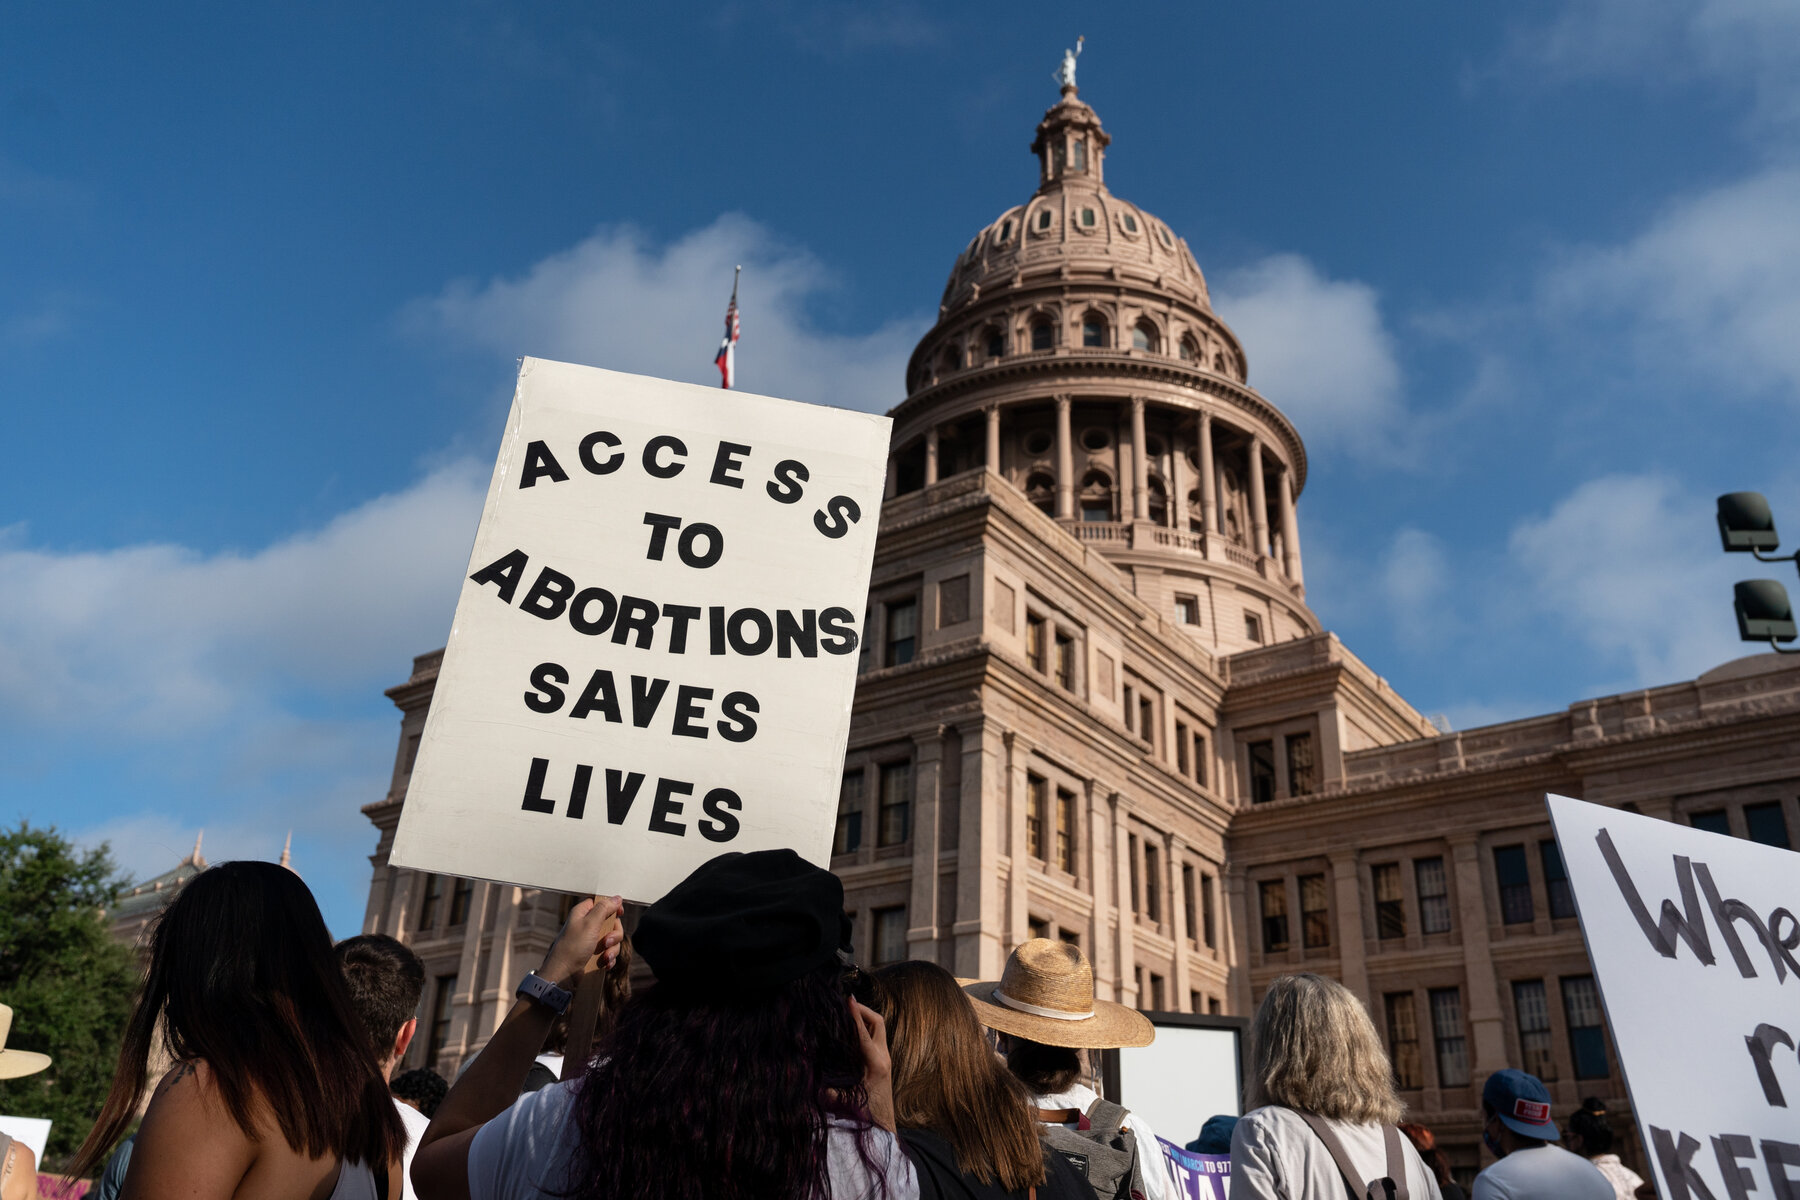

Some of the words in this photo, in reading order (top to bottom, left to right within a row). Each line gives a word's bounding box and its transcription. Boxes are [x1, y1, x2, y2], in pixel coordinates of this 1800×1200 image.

[518, 430, 862, 539] ACCESS
[643, 511, 724, 569] TO
[470, 548, 859, 659] ABORTIONS
[523, 662, 760, 743] SAVES
[520, 757, 743, 843] LIVES
[1204, 1160, 1217, 1174] TO
